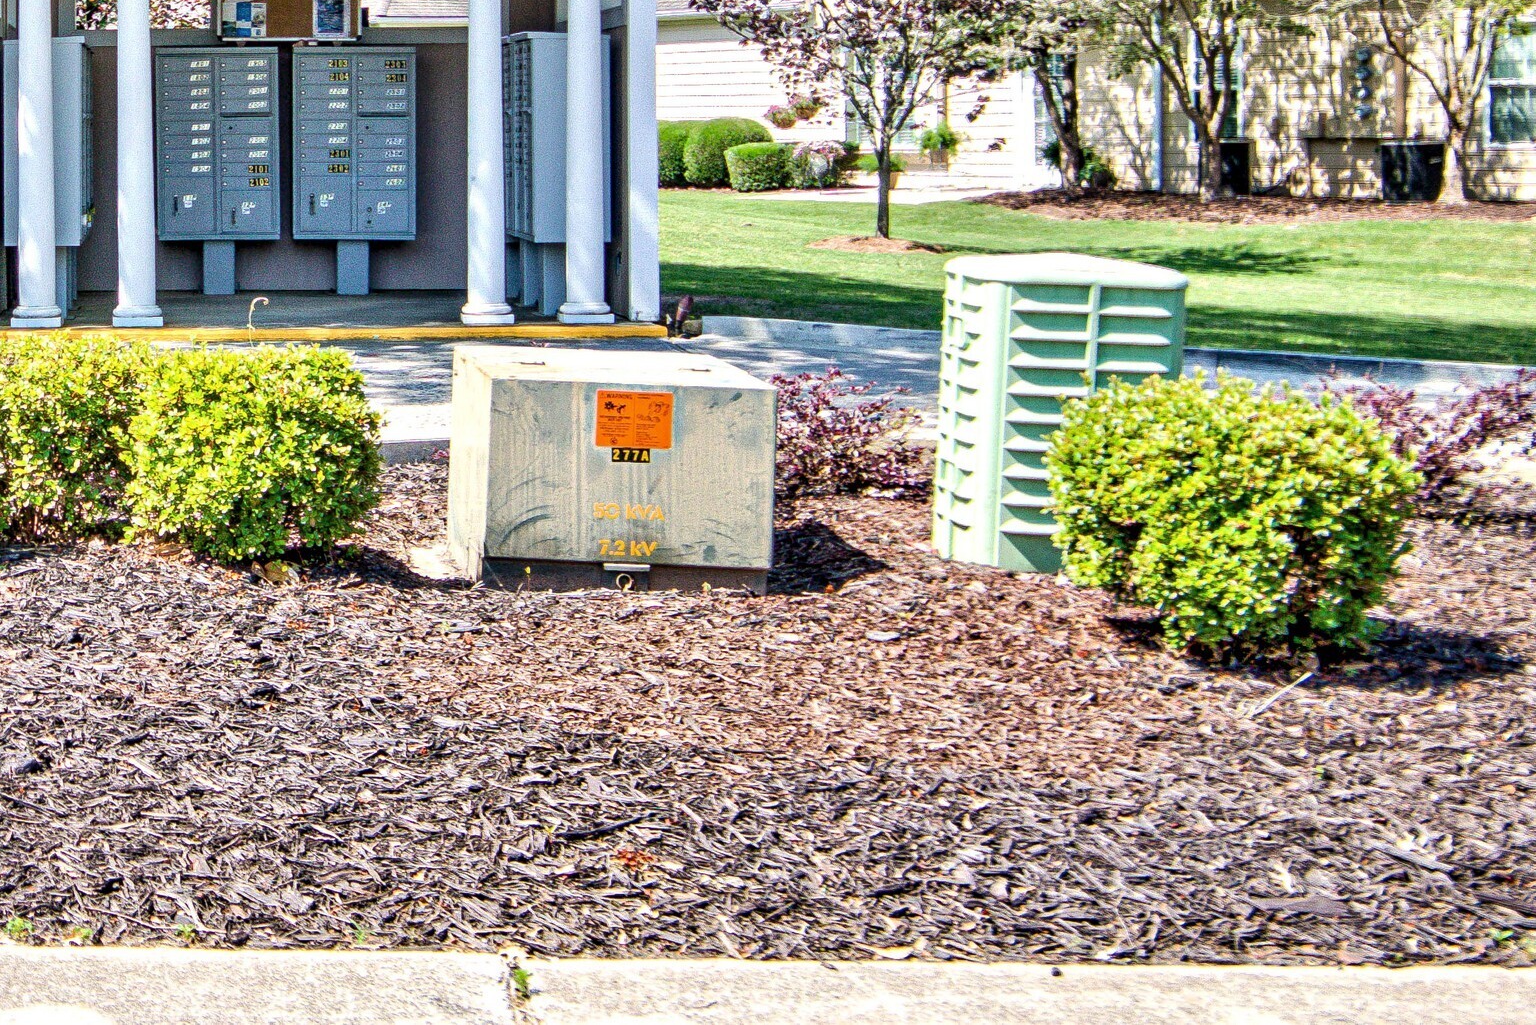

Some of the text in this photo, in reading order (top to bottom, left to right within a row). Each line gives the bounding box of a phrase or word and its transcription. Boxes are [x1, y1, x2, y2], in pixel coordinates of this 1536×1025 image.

[248, 165, 268, 173] 2101
[250, 178, 269, 187] 2102
[613, 449, 649, 461] 277A
[593, 502, 620, 519] 50
[599, 540, 626, 556] 7.2
